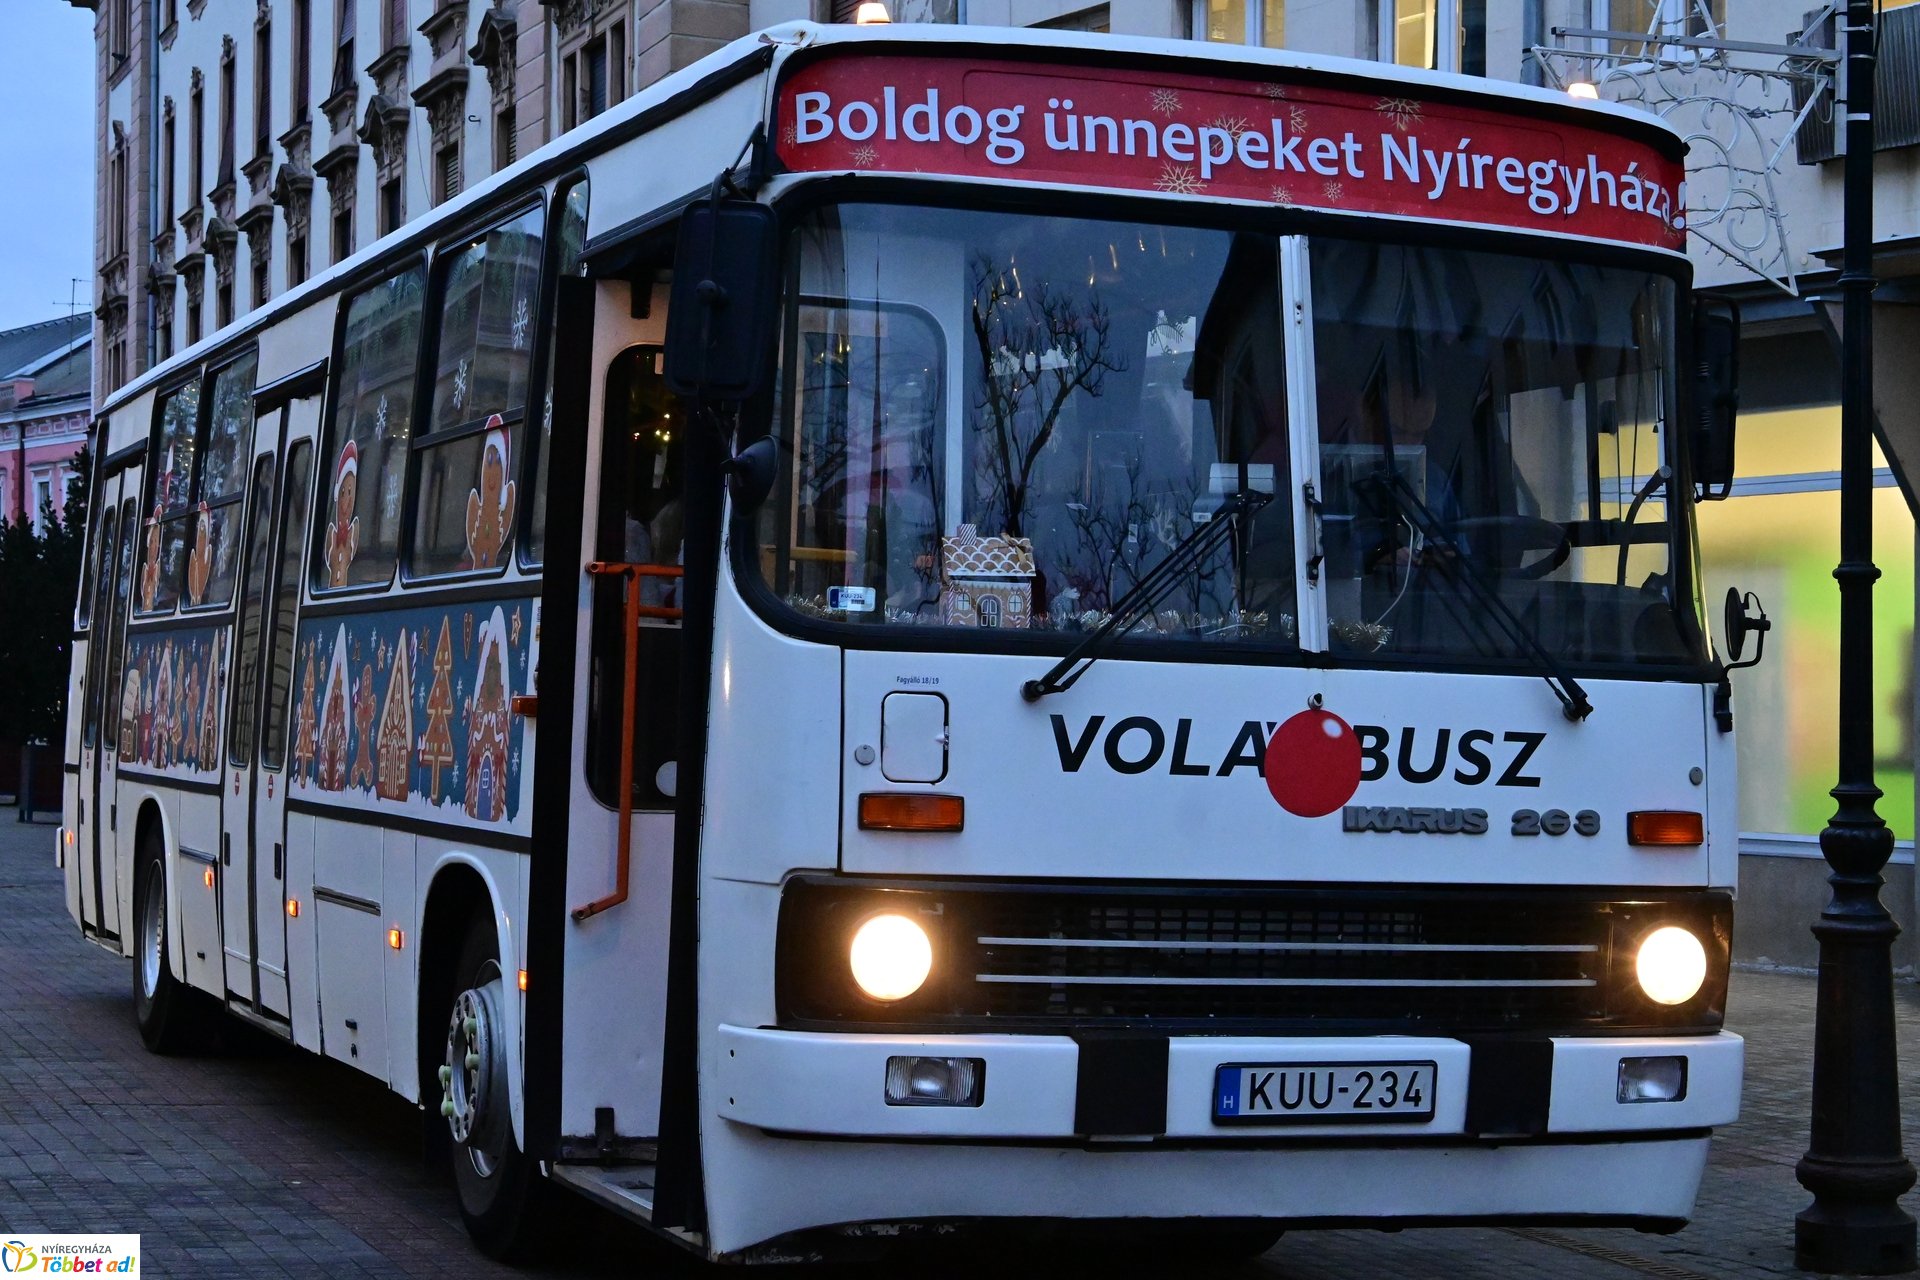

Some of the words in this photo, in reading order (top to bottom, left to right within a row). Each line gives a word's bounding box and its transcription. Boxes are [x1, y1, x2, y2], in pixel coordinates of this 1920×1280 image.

[794, 86, 1025, 165] Boldog
[1044, 97, 1364, 179] ünnepeket
[1050, 713, 1547, 788] VOLABUSZ
[1342, 805, 1489, 835] IKARUS
[1511, 808, 1601, 836] 263
[1223, 1095, 1234, 1109] H
[1249, 1071, 1422, 1110] KUU-234
